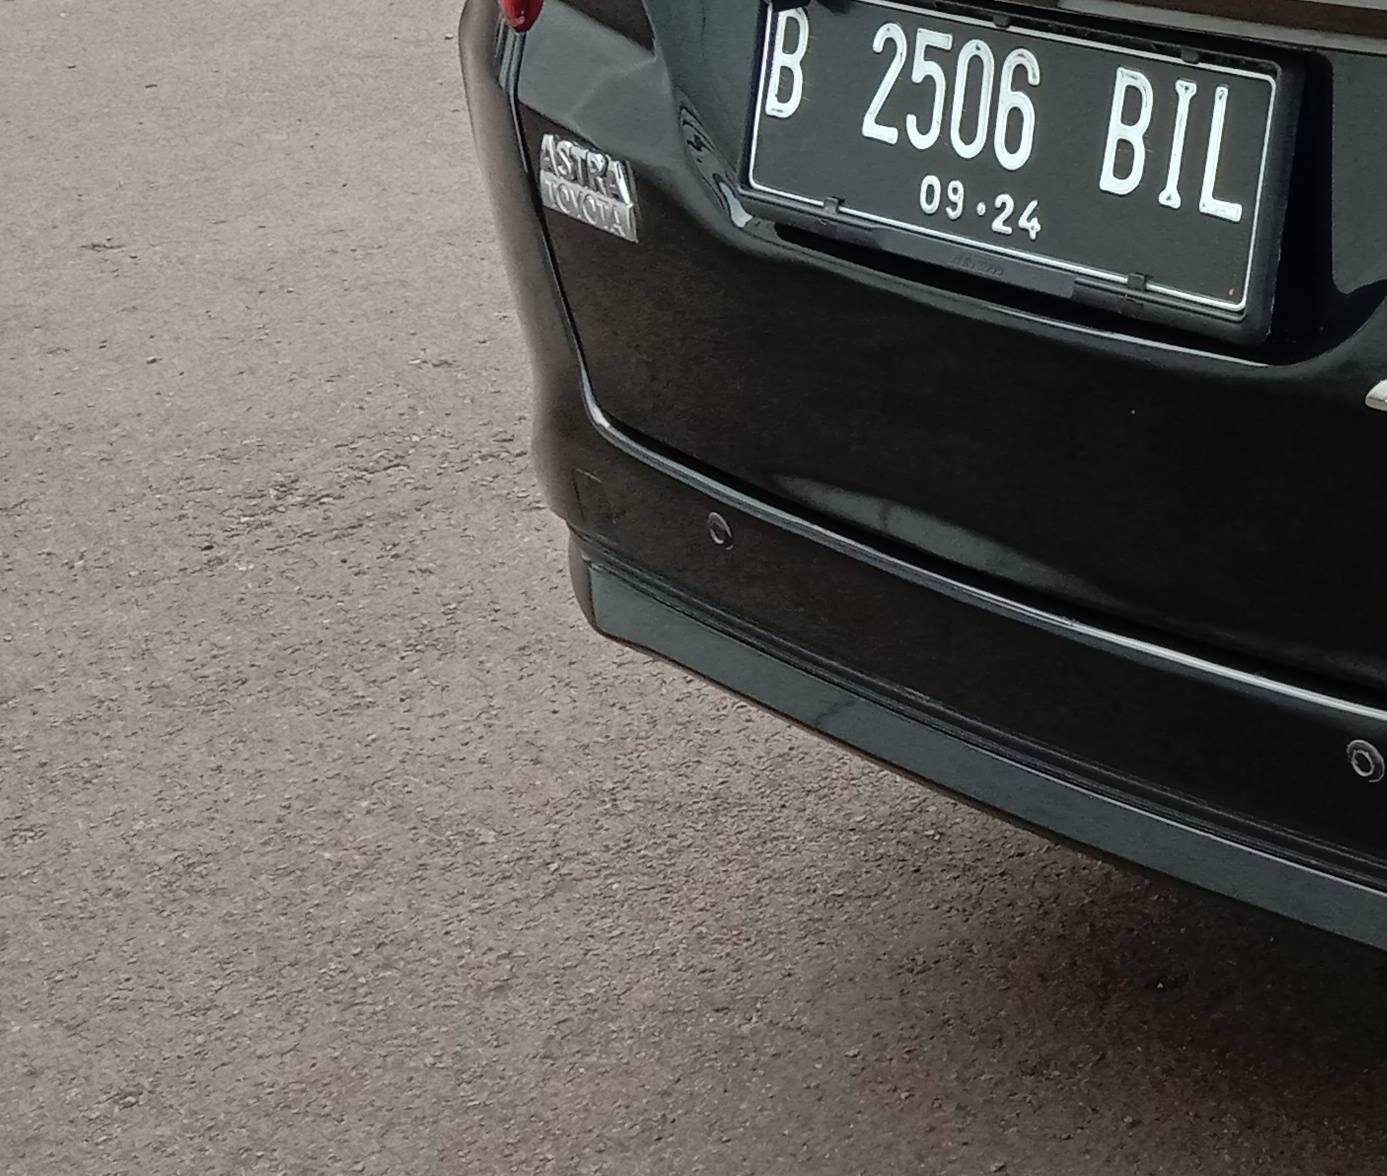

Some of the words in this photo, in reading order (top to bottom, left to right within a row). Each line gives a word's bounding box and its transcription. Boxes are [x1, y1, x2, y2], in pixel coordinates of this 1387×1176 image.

[540, 132, 634, 209] ASTRA
[764, 7, 810, 119] B
[860, 21, 1043, 172] 2506
[1099, 65, 1244, 223] BIL
